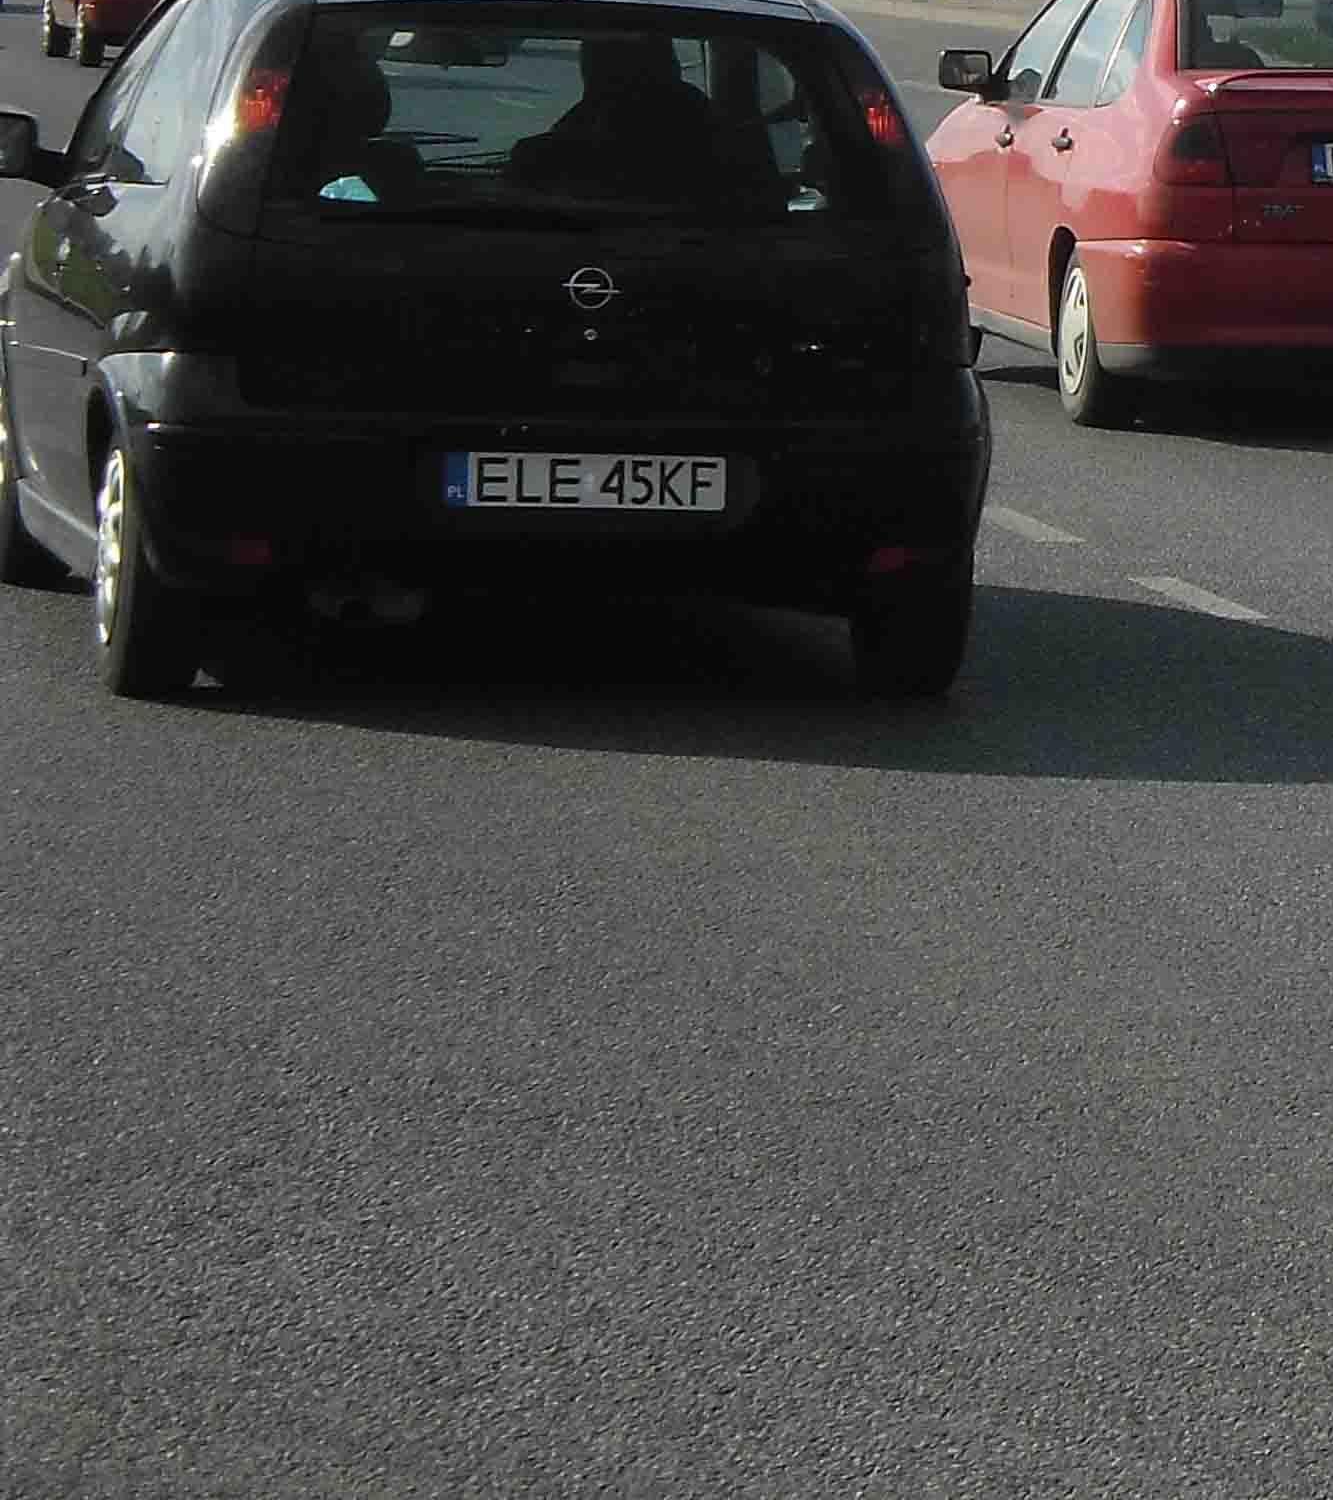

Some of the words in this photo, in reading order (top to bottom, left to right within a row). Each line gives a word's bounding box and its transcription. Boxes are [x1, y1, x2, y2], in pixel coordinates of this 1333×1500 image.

[447, 484, 465, 499] PL
[476, 456, 582, 504] ELE
[599, 459, 718, 507] 45KF
